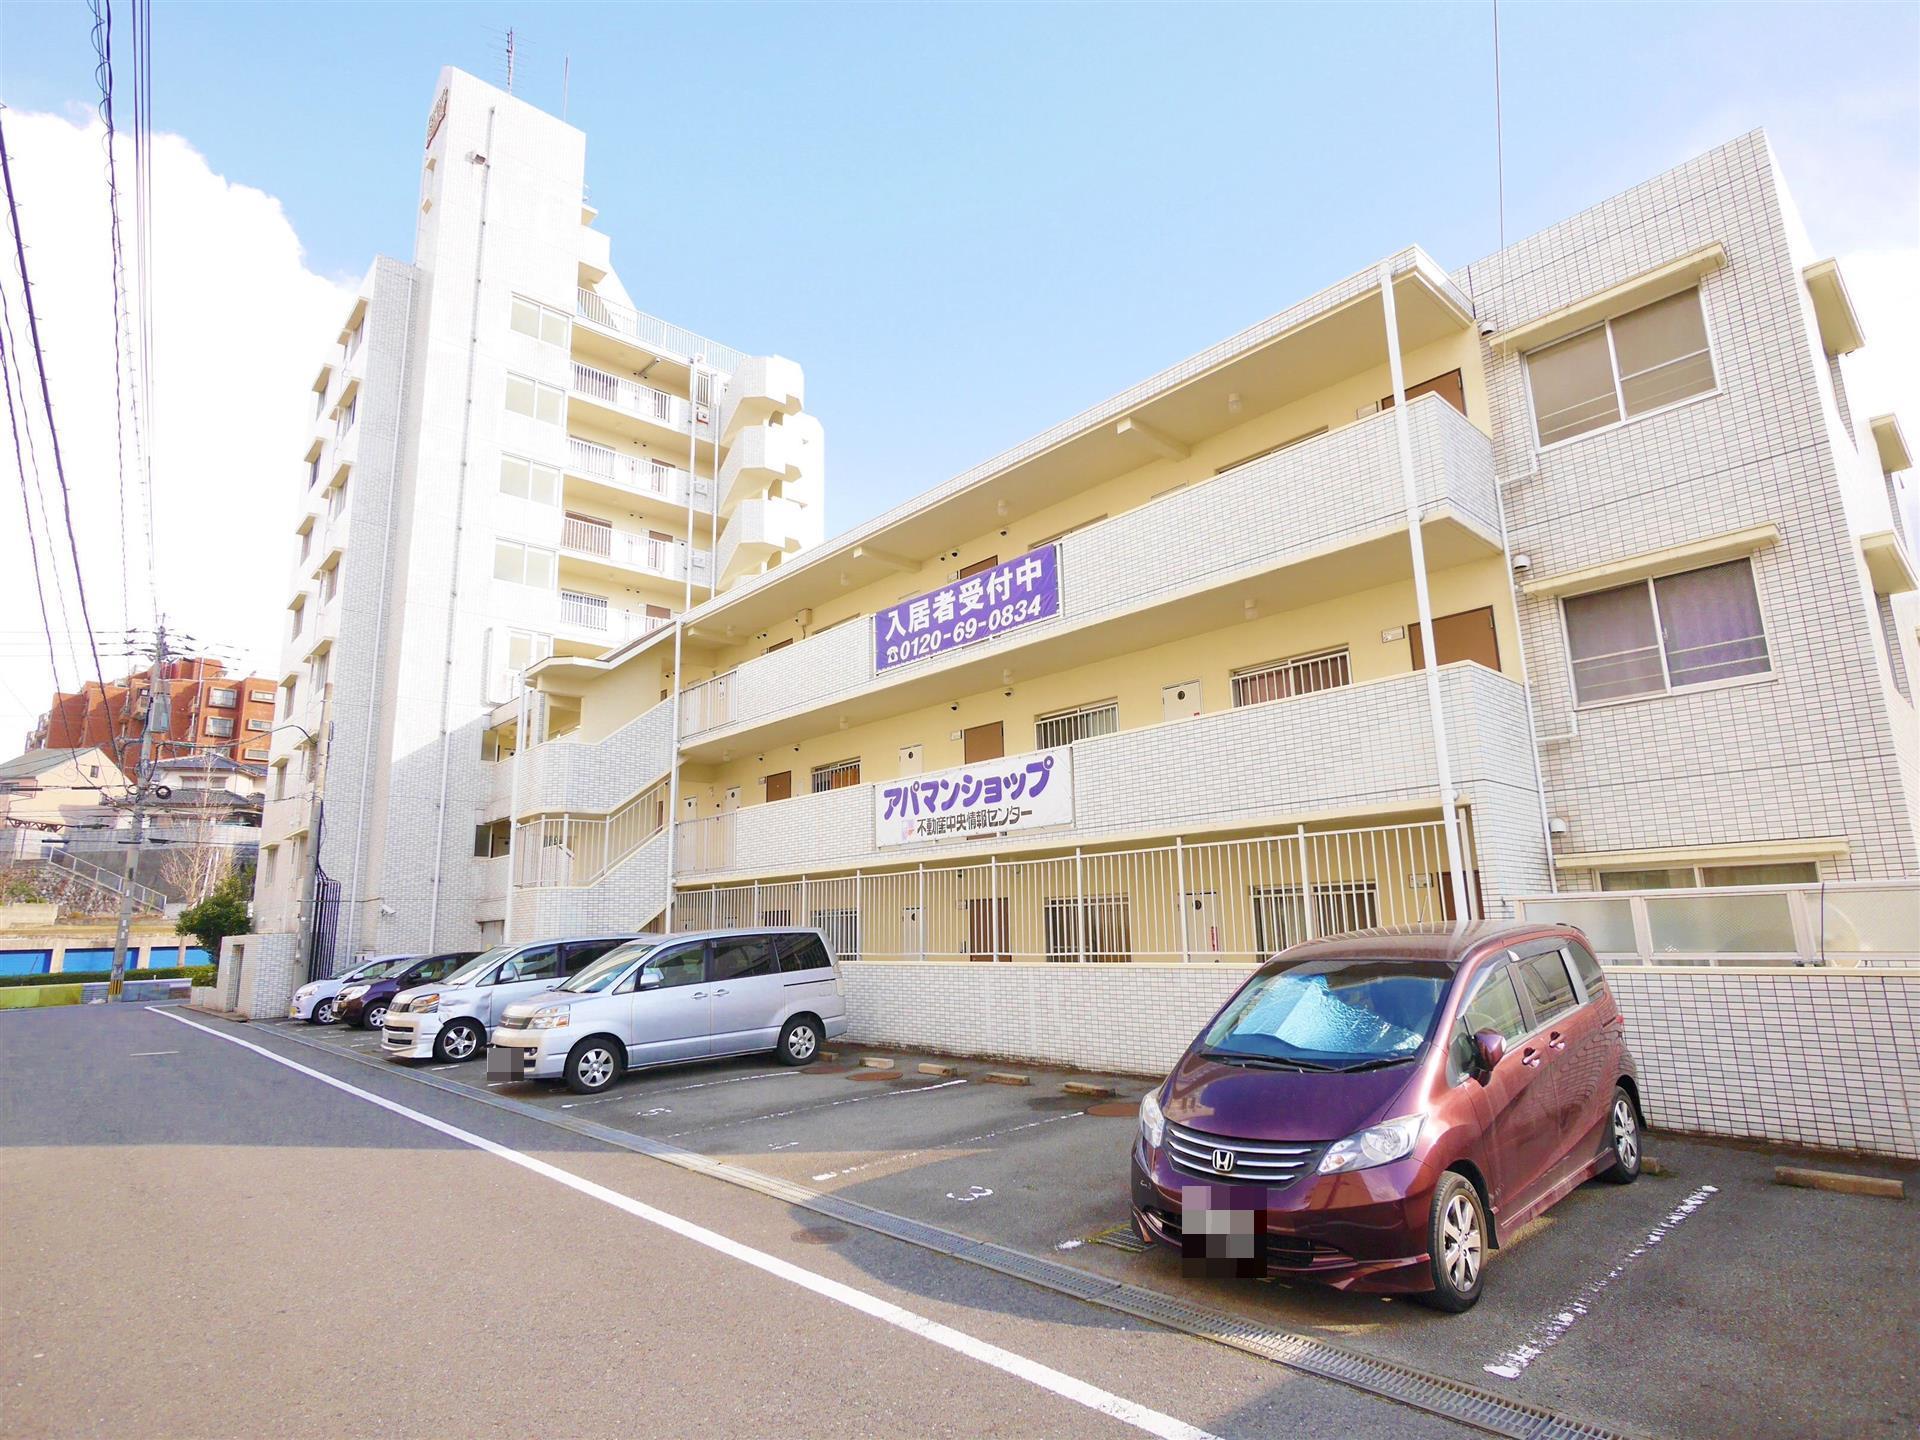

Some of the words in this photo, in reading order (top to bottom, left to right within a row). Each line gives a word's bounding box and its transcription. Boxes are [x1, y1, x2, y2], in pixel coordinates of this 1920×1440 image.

[885, 557, 1042, 641] 入居者受付中
[900, 594, 1041, 660] 0120-69-0834
[883, 755, 1054, 820] アパマンショップ
[917, 805, 1032, 837] 不動産中央情報センター
